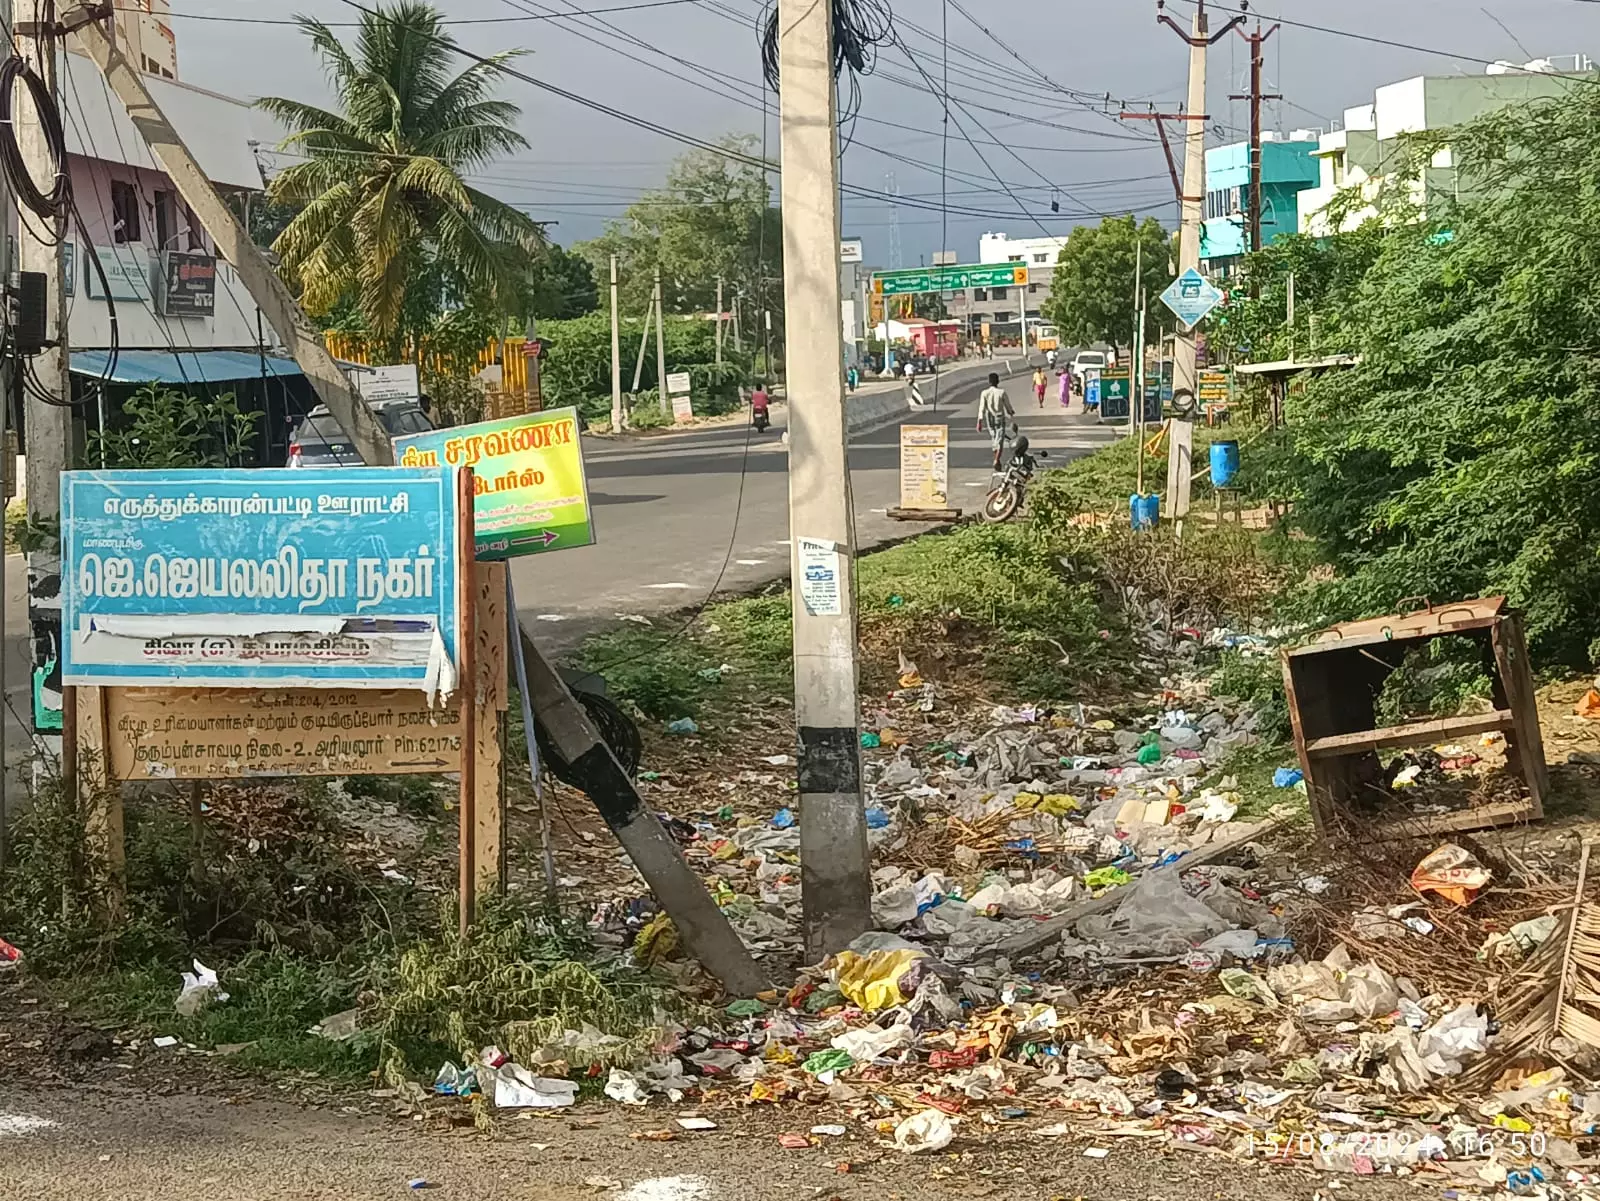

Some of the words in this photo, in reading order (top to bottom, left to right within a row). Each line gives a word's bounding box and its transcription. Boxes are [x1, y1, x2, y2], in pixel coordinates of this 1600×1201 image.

[445, 420, 573, 467] சரவணா
[103, 493, 313, 521] எருத்துக்காரன்பட்டி
[317, 491, 409, 517] ஊராட்சி
[79, 544, 349, 614] ஜெ.ஜெயலலிதா
[355, 543, 436, 615] நகர்
[256, 712, 298, 731] மற்றும்
[301, 709, 394, 732] குடியிருப்போர்
